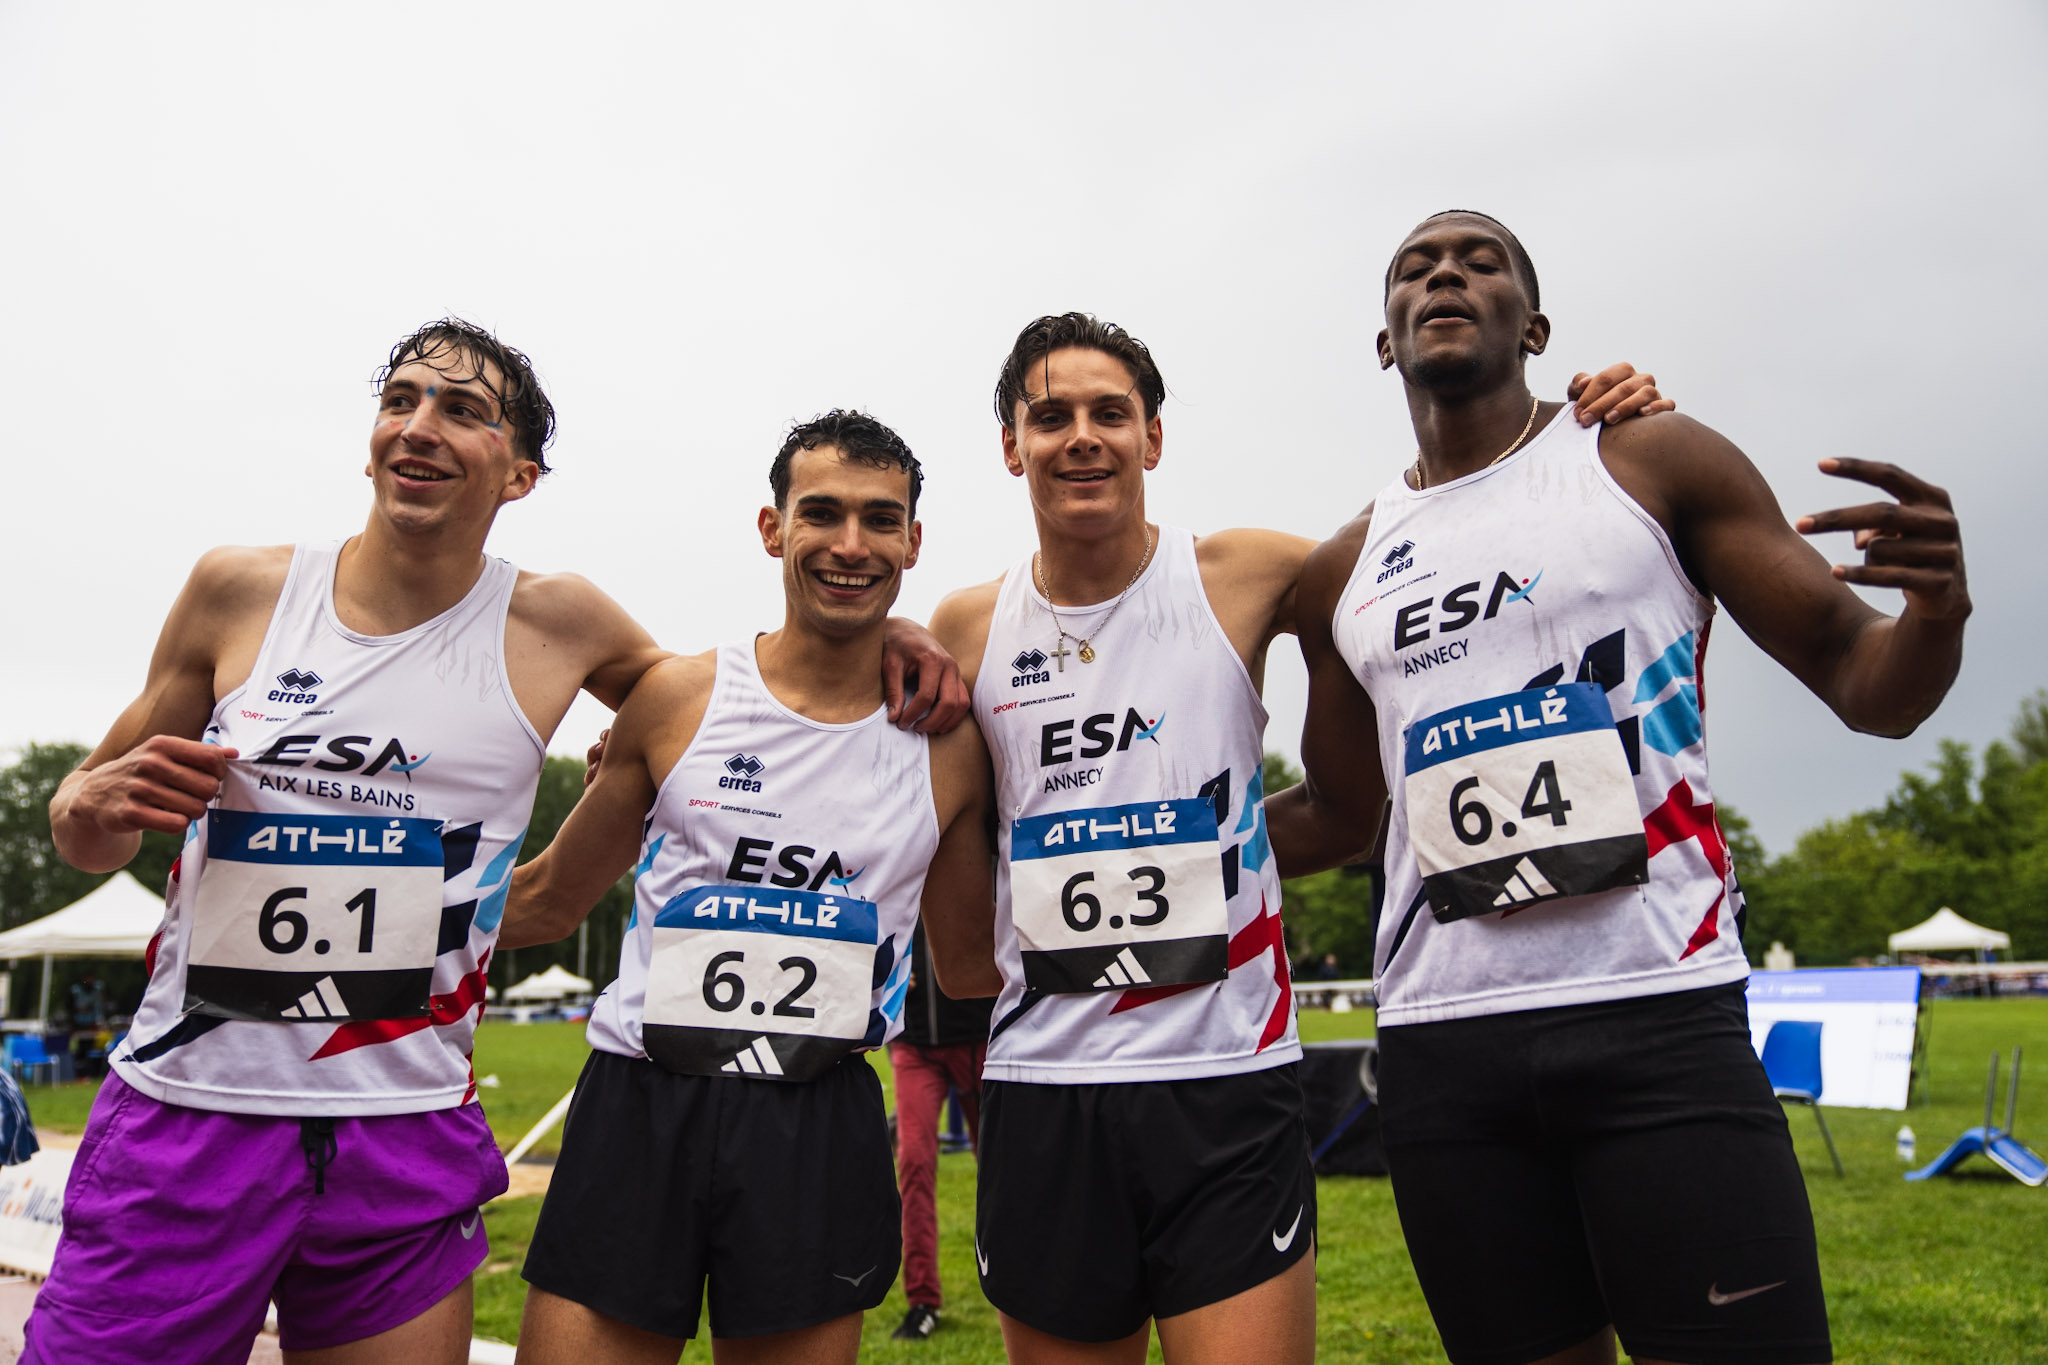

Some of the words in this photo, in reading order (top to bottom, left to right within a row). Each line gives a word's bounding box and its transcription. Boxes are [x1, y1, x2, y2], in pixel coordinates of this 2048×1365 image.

[1377, 557, 1413, 584] errea
[1394, 567, 1544, 652] ESA
[1012, 670, 1050, 688] errea
[1404, 638, 1469, 679] ANNECY
[267, 690, 318, 704] errea
[993, 701, 1019, 715] SPORT
[1019, 698, 1046, 707] SERVICES
[1047, 692, 1075, 702] CONSEILS
[1040, 707, 1166, 767] ESA
[1422, 688, 1567, 756] ATHLÉ
[252, 735, 432, 783] ESA
[259, 774, 298, 793] AIX
[306, 779, 343, 799] LES
[351, 785, 415, 811] BAINS
[718, 776, 762, 793] errea
[1044, 766, 1104, 794] ANNECY
[688, 799, 720, 809] SPORT
[720, 805, 751, 814] SERVICES
[751, 809, 782, 818] CONSEILS
[1449, 760, 1572, 846] 6.4
[248, 819, 407, 854] ATHLÉ
[1044, 802, 1177, 847] ATHLÉ
[726, 836, 866, 898] ESA
[694, 896, 840, 928] ATHLÉ
[1061, 866, 1170, 933] 6.3
[258, 887, 377, 954] 6.1
[702, 951, 817, 1019] 6.2
